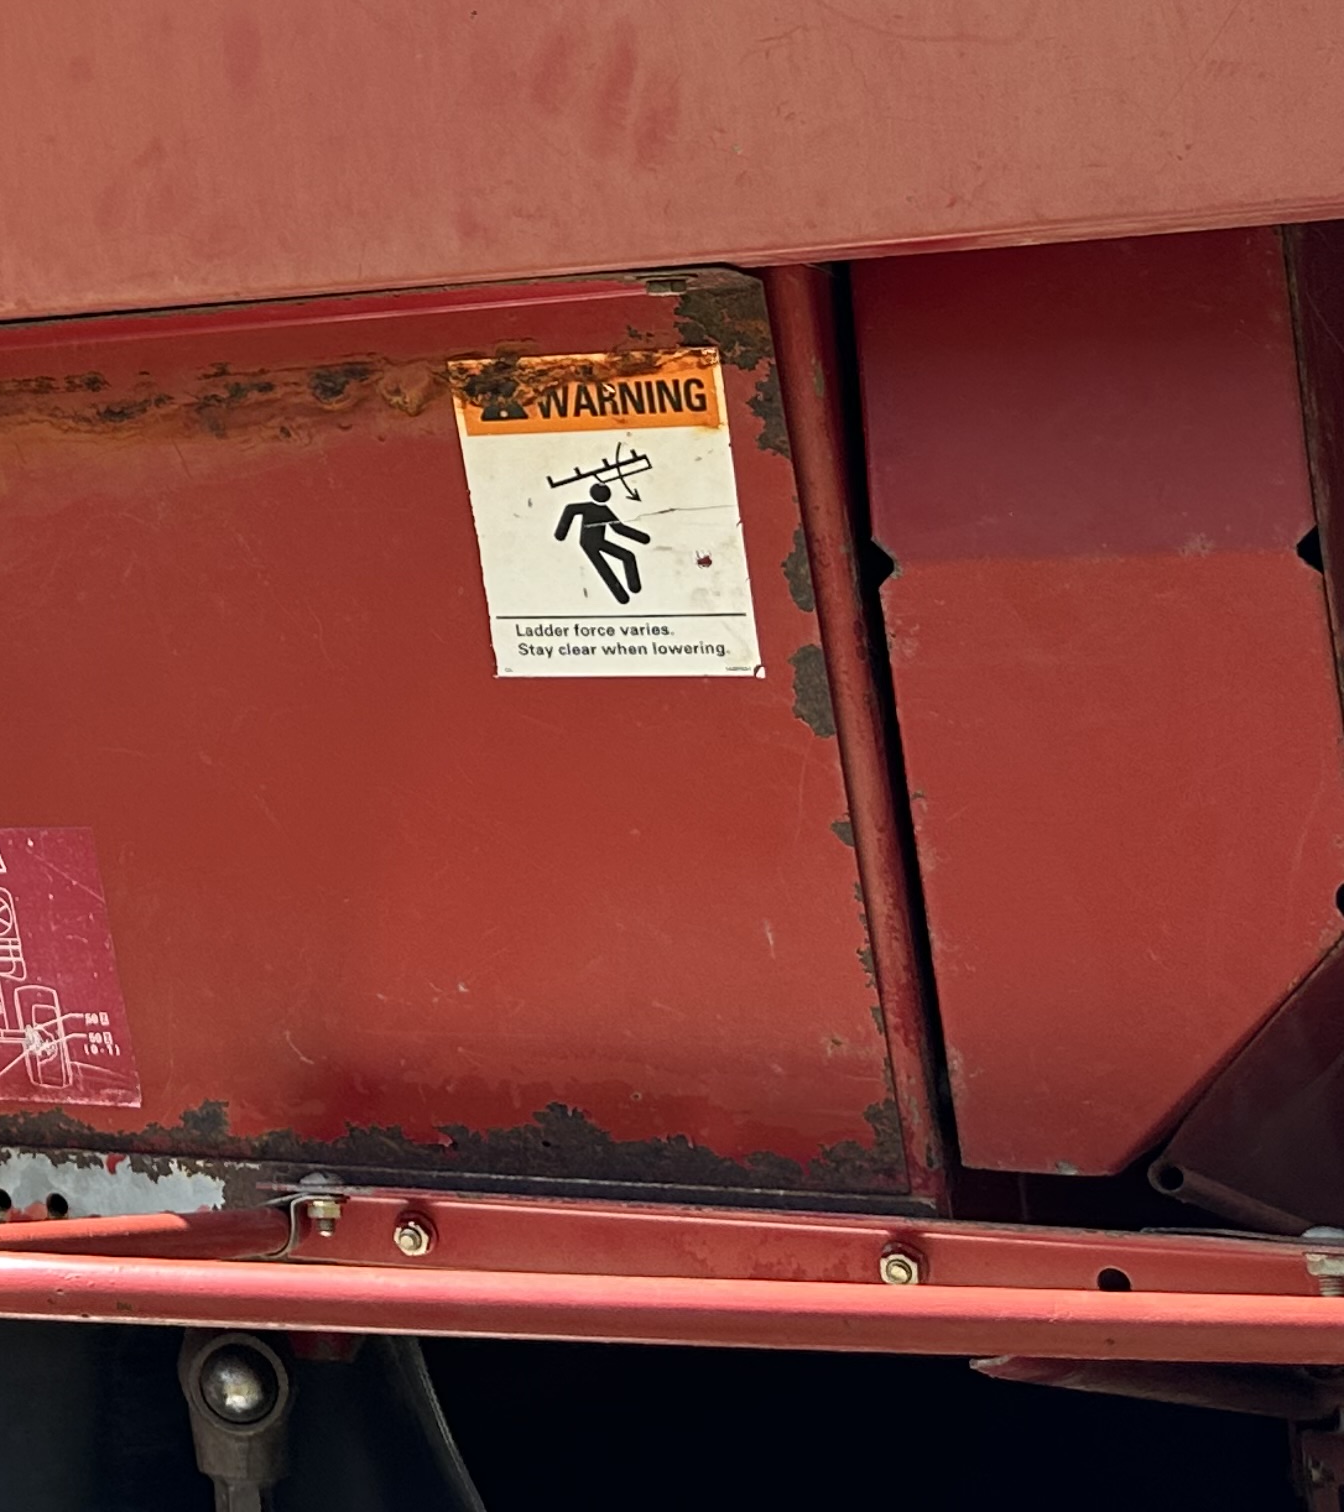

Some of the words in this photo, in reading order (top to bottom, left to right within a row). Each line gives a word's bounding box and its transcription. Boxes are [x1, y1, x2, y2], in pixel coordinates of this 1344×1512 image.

[535, 377, 707, 420] WARNING
[515, 623, 569, 637] Ladder
[574, 623, 615, 637] force
[621, 623, 674, 637] varies.
[518, 642, 553, 658] Stay
[558, 642, 596, 656] clear
[601, 641, 648, 656] when
[652, 641, 730, 657] lowering.
